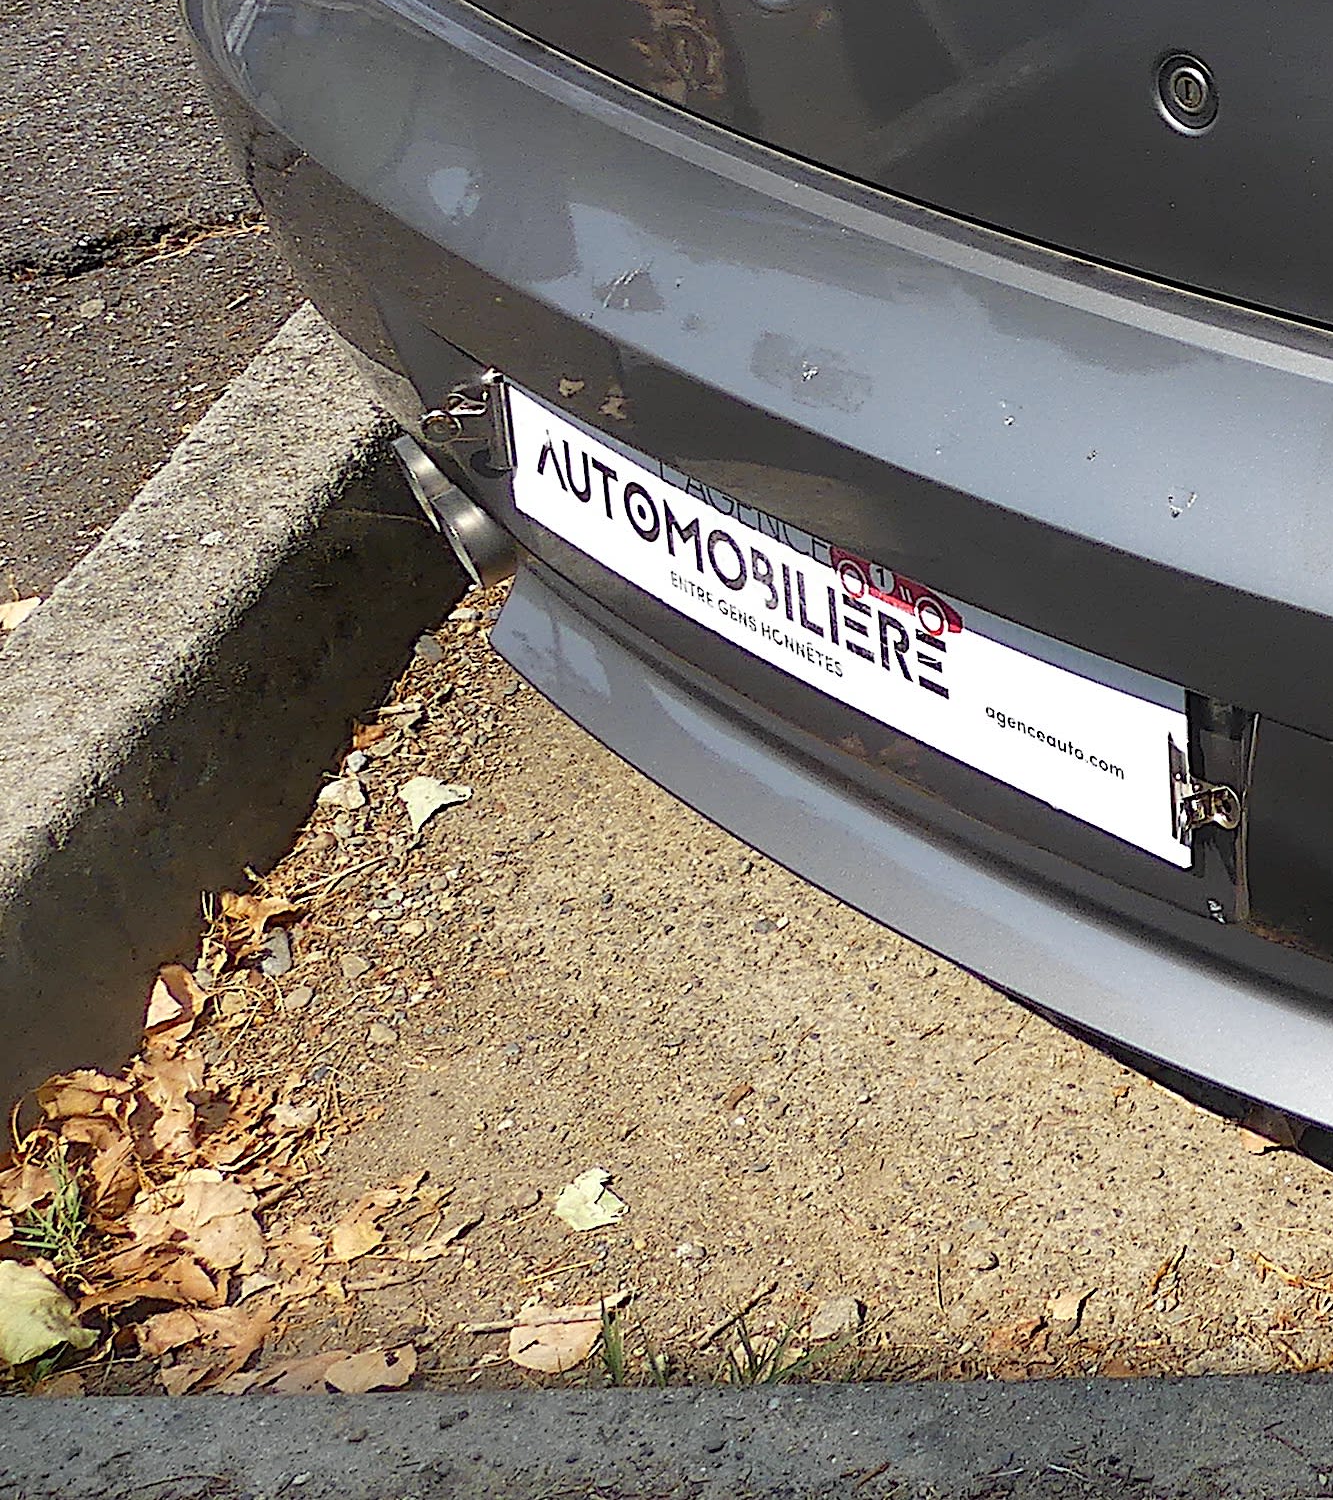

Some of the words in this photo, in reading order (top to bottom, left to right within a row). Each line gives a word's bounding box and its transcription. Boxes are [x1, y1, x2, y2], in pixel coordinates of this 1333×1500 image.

[669, 570, 714, 609] ENTRE
[717, 598, 757, 632] GENS
[760, 621, 844, 678] HONNÊTES
[985, 705, 1125, 781] agenceauto.com
